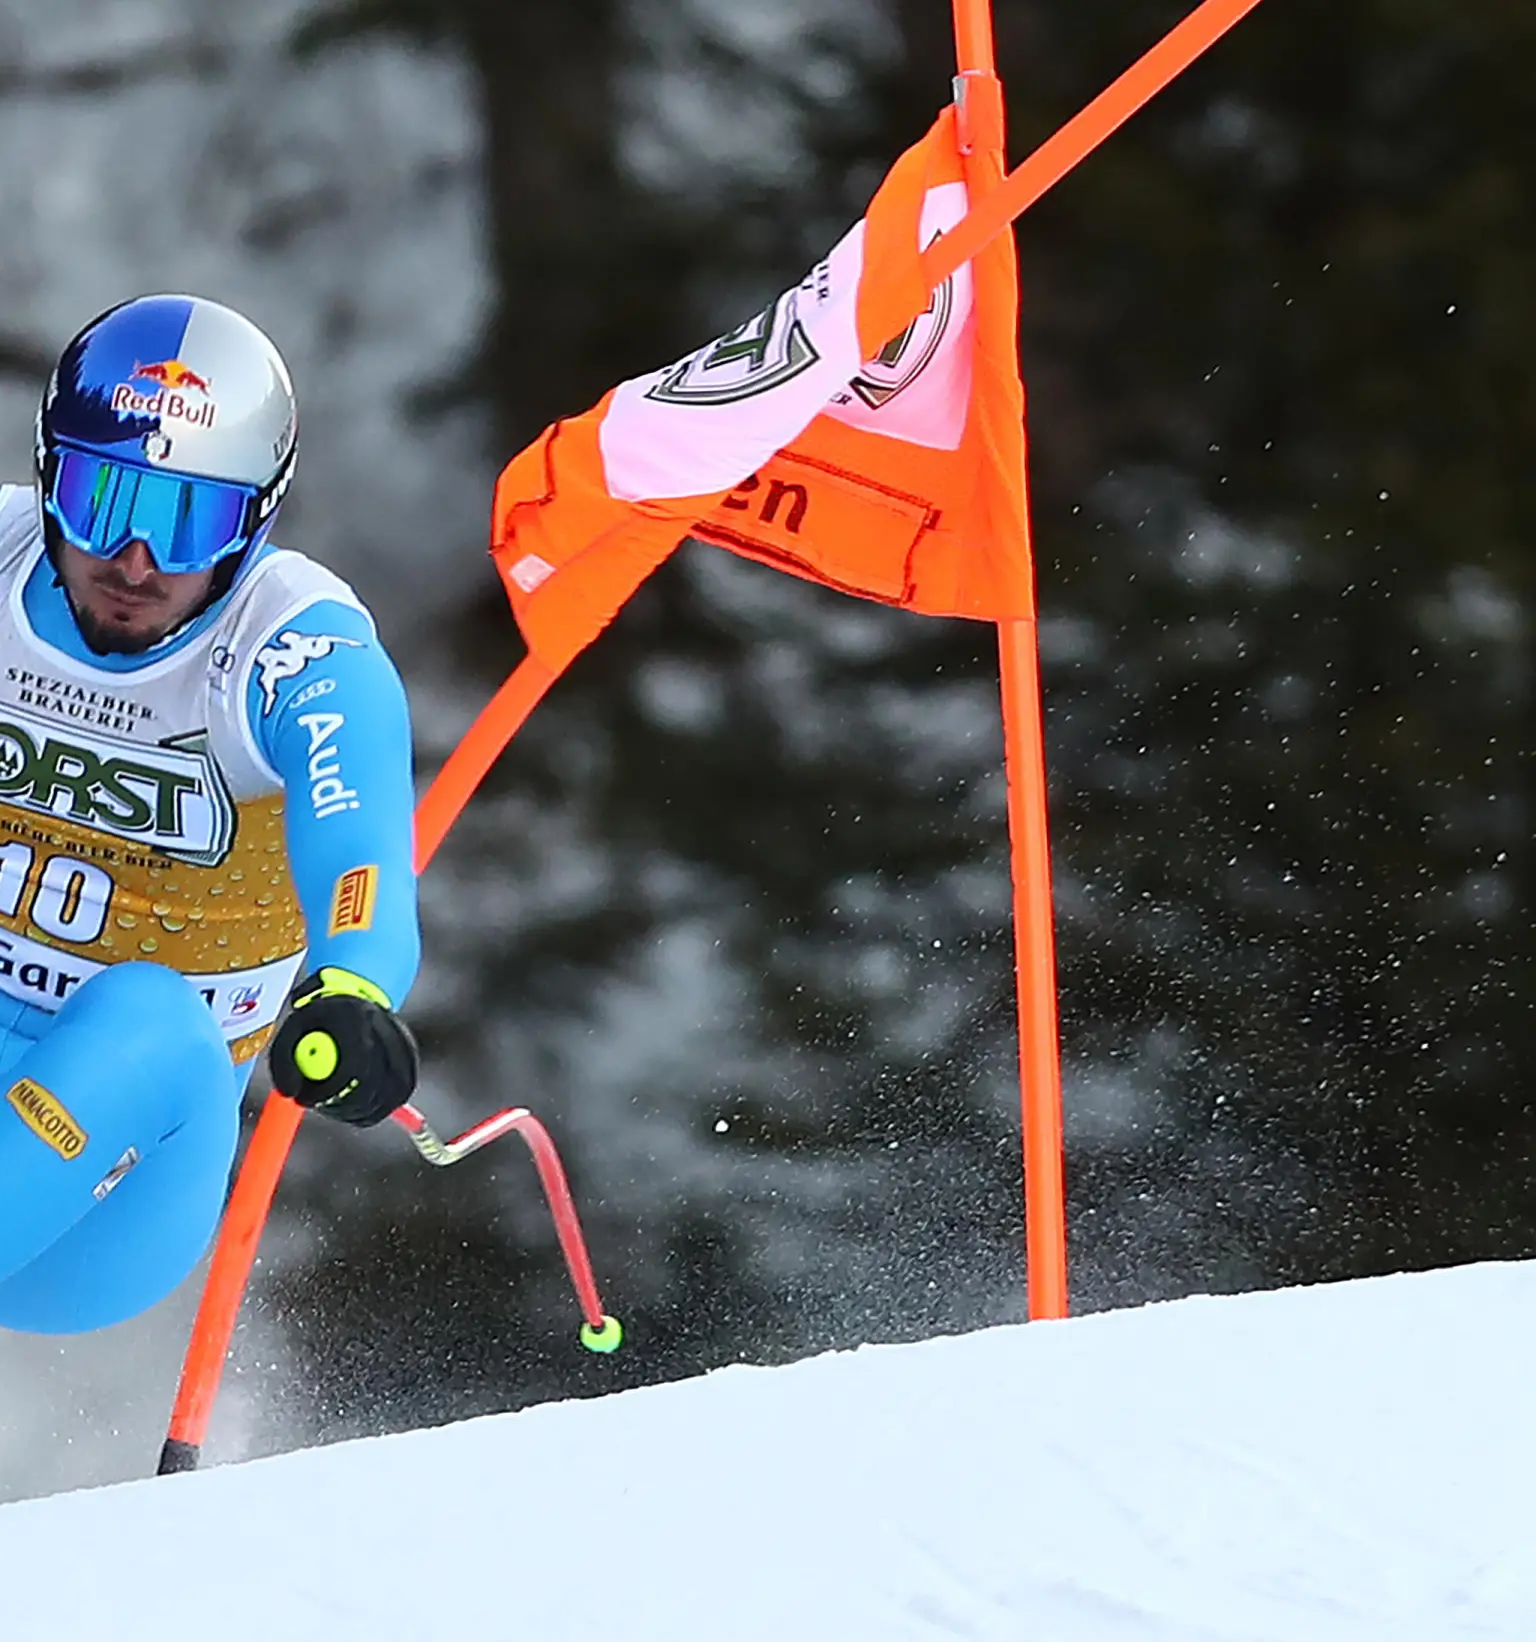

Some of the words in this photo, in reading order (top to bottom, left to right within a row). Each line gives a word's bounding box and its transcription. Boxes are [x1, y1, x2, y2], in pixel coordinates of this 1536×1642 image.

[114, 385, 162, 413] Red
[168, 392, 215, 428] Bull
[20, 689, 136, 732] BRAUEREI
[298, 711, 360, 820] Audi
[335, 868, 369, 928] PIRELLI
